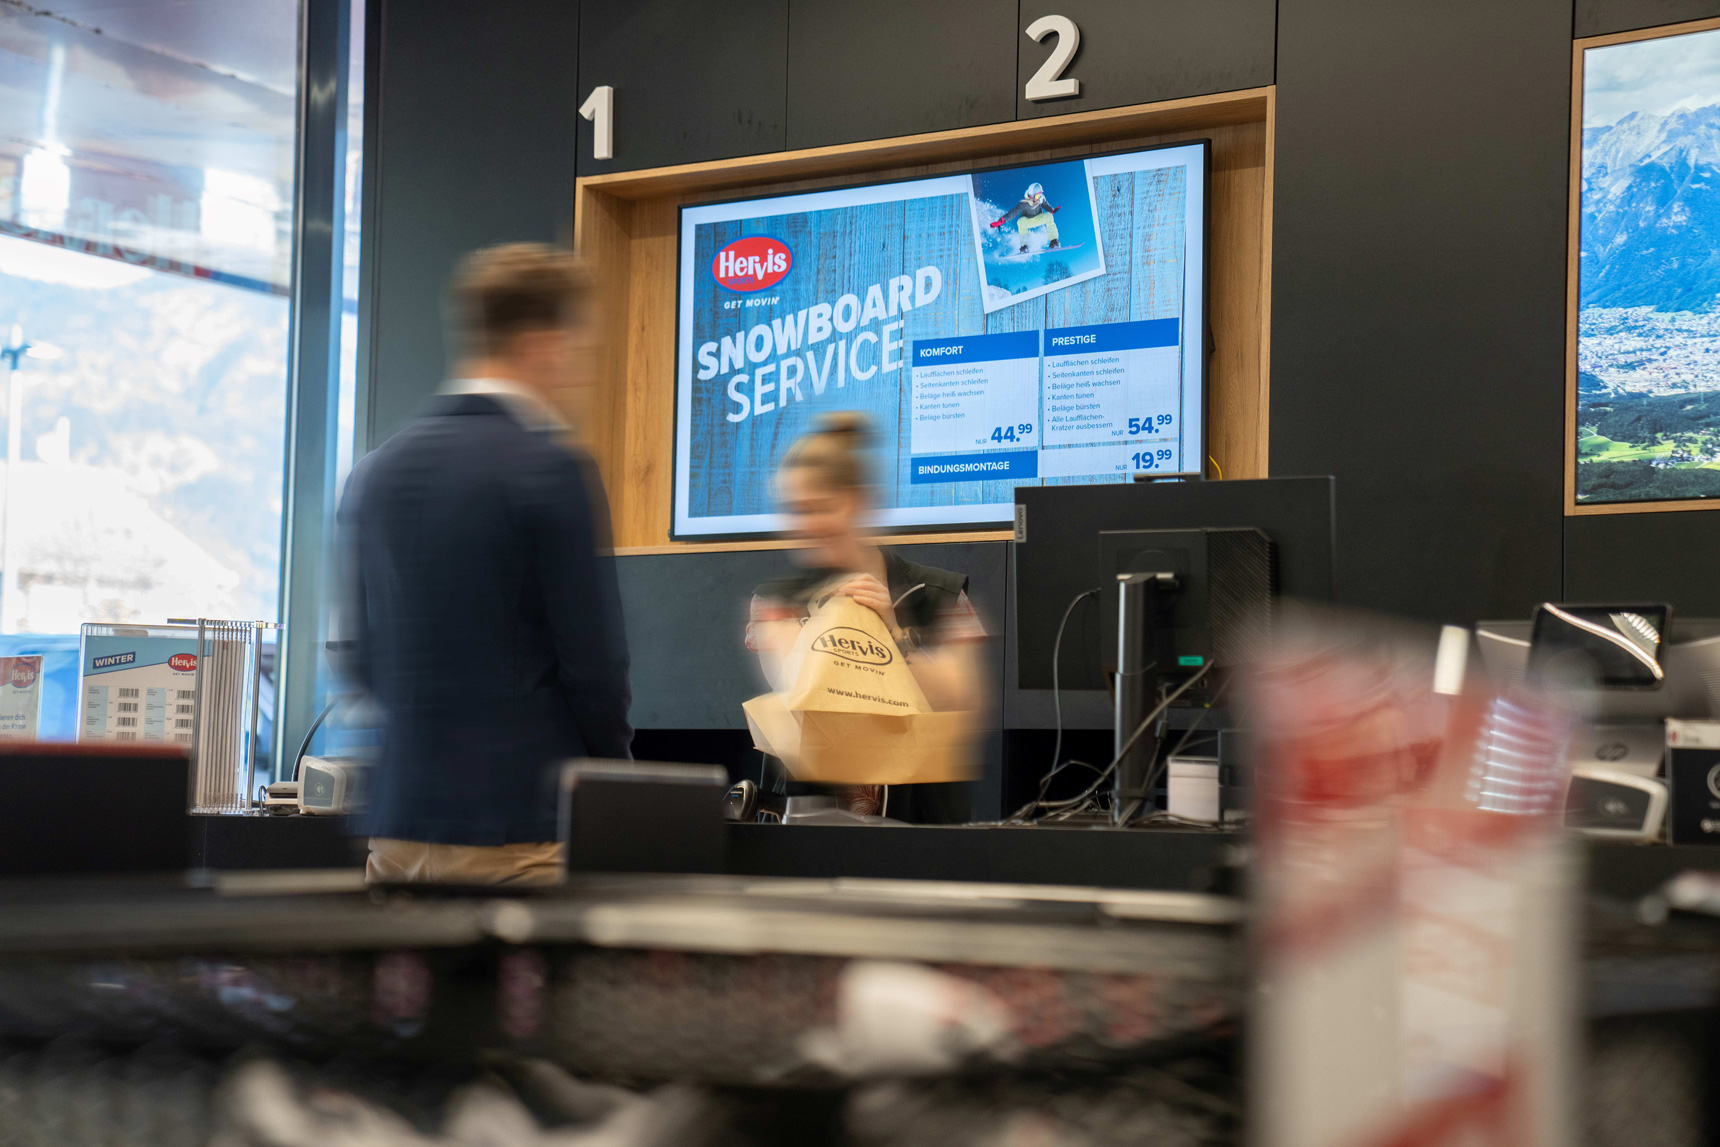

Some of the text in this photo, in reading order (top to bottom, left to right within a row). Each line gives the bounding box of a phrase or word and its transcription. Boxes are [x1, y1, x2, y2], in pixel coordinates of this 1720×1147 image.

[1024, 14, 1081, 101] 2
[578, 85, 614, 159] 1
[719, 248, 787, 280] Hervis
[728, 276, 754, 286] SPORTS
[723, 300, 743, 310] GET
[697, 265, 942, 381] SNOWBOARD
[1052, 334, 1097, 347] PRESTIGE
[920, 345, 963, 358] KOMFORT
[1090, 356, 1120, 365] schleifen
[726, 320, 905, 423] SERVICE
[956, 367, 984, 376] schleifen
[1052, 367, 1125, 379] Seitenkanten schleifen
[920, 377, 989, 389] Seitenkanten schleifen
[1052, 379, 1121, 391] Beläge heiß wachsen
[920, 392, 941, 400] Beläge
[957, 389, 985, 397] wachsen
[1051, 403, 1101, 413] Beläge bürsten
[920, 412, 966, 422] Beläge bürsten
[1051, 422, 1113, 432] Kratzer ausbessern
[1128, 414, 1173, 435] 54.99
[990, 423, 1033, 443] 44.99
[1131, 448, 1173, 470] 19.99
[918, 461, 1010, 475] BINDUNGSMONTAGE
[819, 634, 886, 659] Hervis
[833, 647, 859, 657] SPORTS
[95, 653, 134, 667] WINTER
[171, 657, 197, 668] Hervis
[833, 660, 851, 668] GET
[12, 669, 34, 683] Hervis
[827, 687, 909, 708] www.hervis.com
